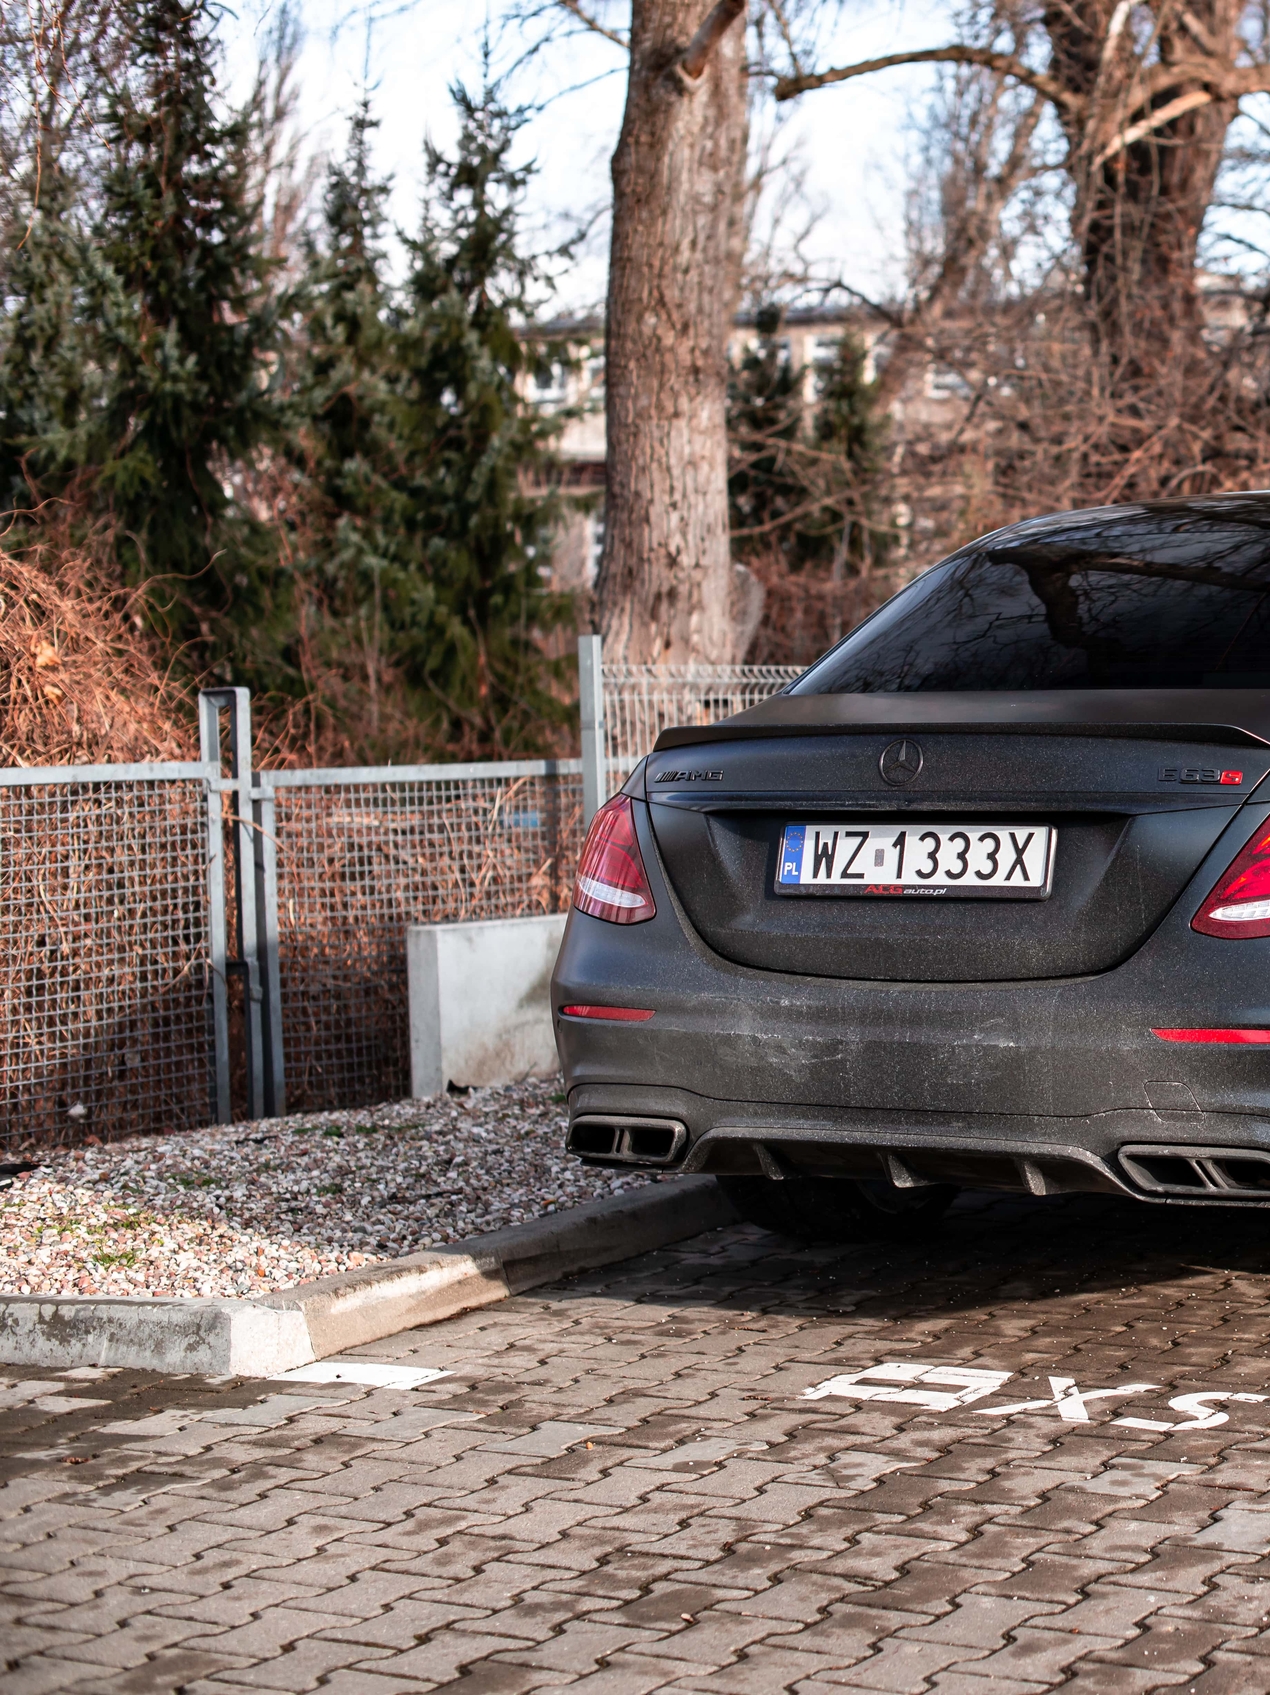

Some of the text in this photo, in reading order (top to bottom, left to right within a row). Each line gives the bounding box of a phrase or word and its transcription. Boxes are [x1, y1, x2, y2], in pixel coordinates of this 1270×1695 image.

[674, 769, 724, 781] AMG
[812, 830, 1036, 882] WZ 1333X
[783, 862, 799, 876] PL
